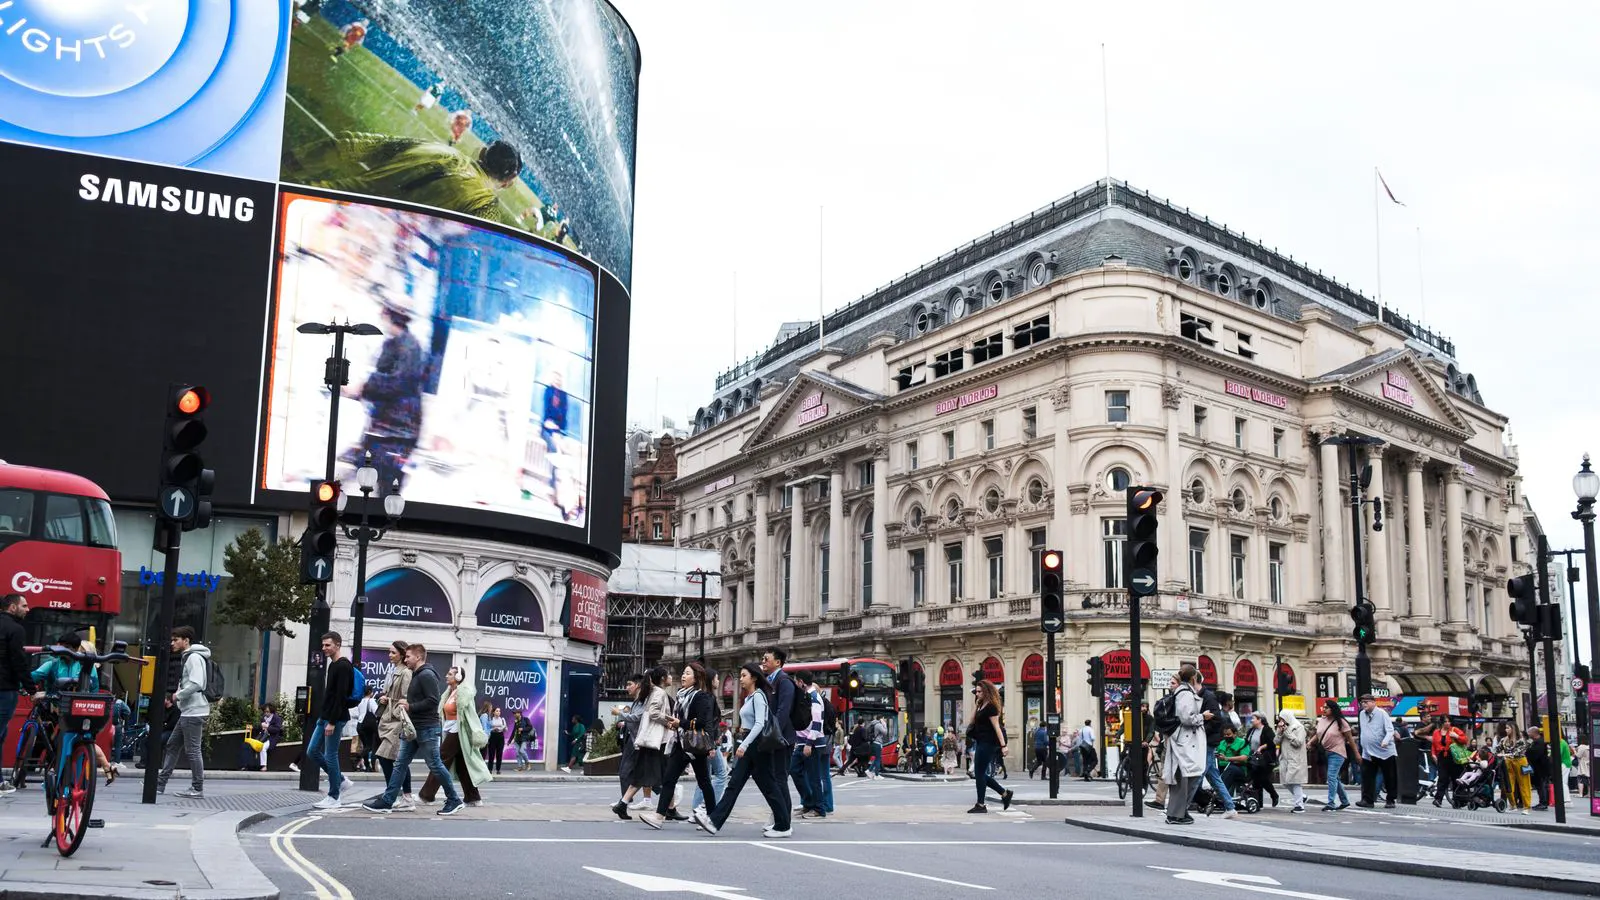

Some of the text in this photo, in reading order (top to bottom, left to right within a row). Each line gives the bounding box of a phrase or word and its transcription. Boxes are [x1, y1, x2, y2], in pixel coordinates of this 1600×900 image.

[79, 173, 255, 222] SAMSUNG
[1389, 373, 1408, 389] BODY
[802, 393, 821, 410] BODY
[936, 386, 996, 414] BODY WORLDS
[1228, 381, 1287, 408] BODY WORLDS
[1384, 385, 1415, 406] WORLDS
[797, 404, 827, 425] WORLDS
[11, 571, 44, 594] Go
[378, 603, 422, 617] LUCENT
[578, 600, 584, 613] of
[490, 613, 522, 626] LUCENT
[1109, 654, 1131, 664] LONDO
[361, 661, 394, 675] PRIM
[480, 668, 541, 684] ILLUMINATED
[1105, 664, 1131, 675] PAVILI
[485, 682, 509, 698] by an
[505, 697, 529, 710] ICON
